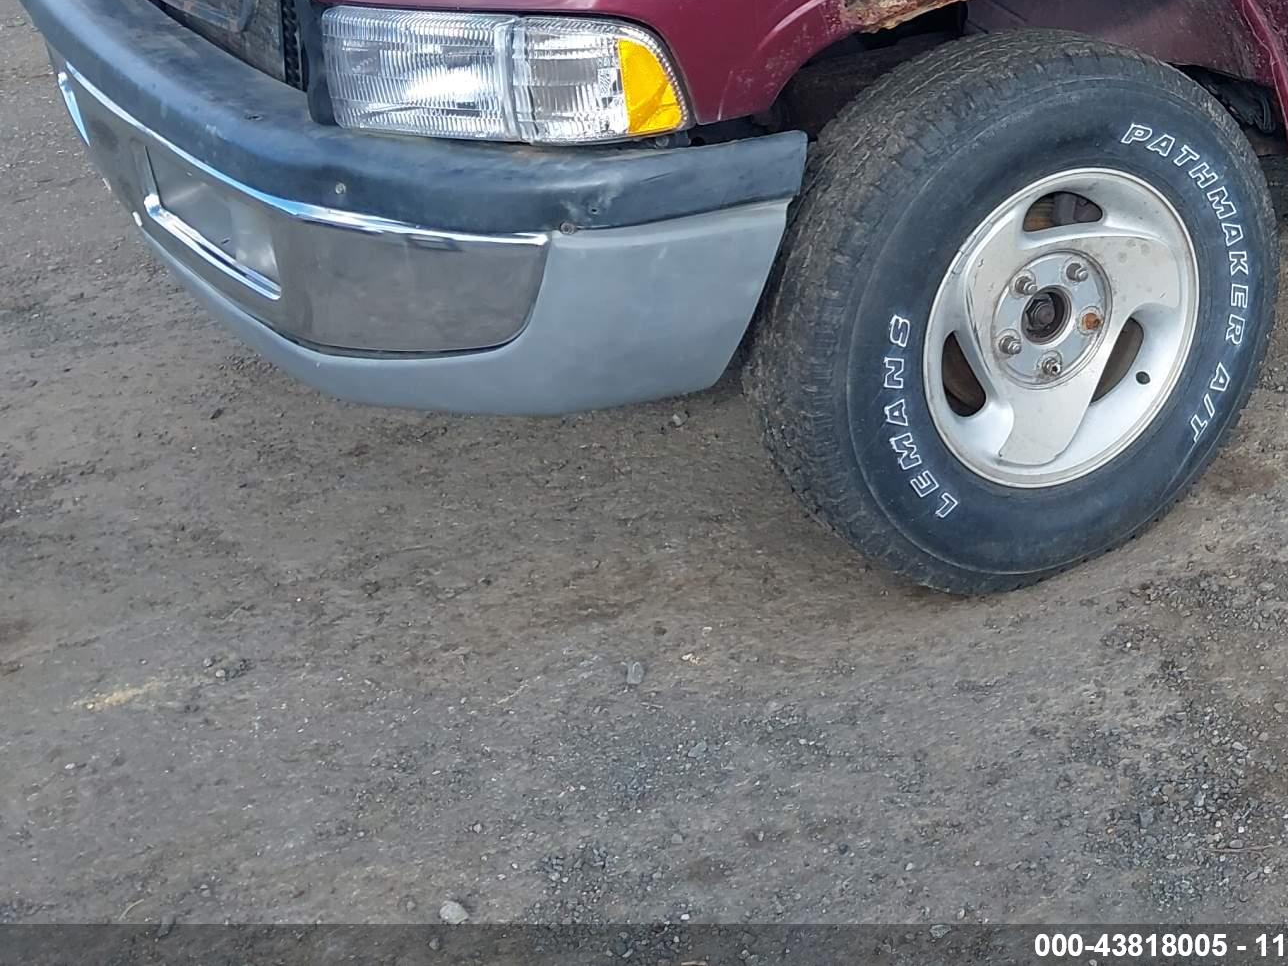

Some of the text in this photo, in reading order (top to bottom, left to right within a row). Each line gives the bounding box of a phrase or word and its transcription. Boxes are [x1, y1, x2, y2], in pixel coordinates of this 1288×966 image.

[1120, 122, 1250, 444] PATHMAKER A/T
[884, 314, 958, 519] LEMANS
